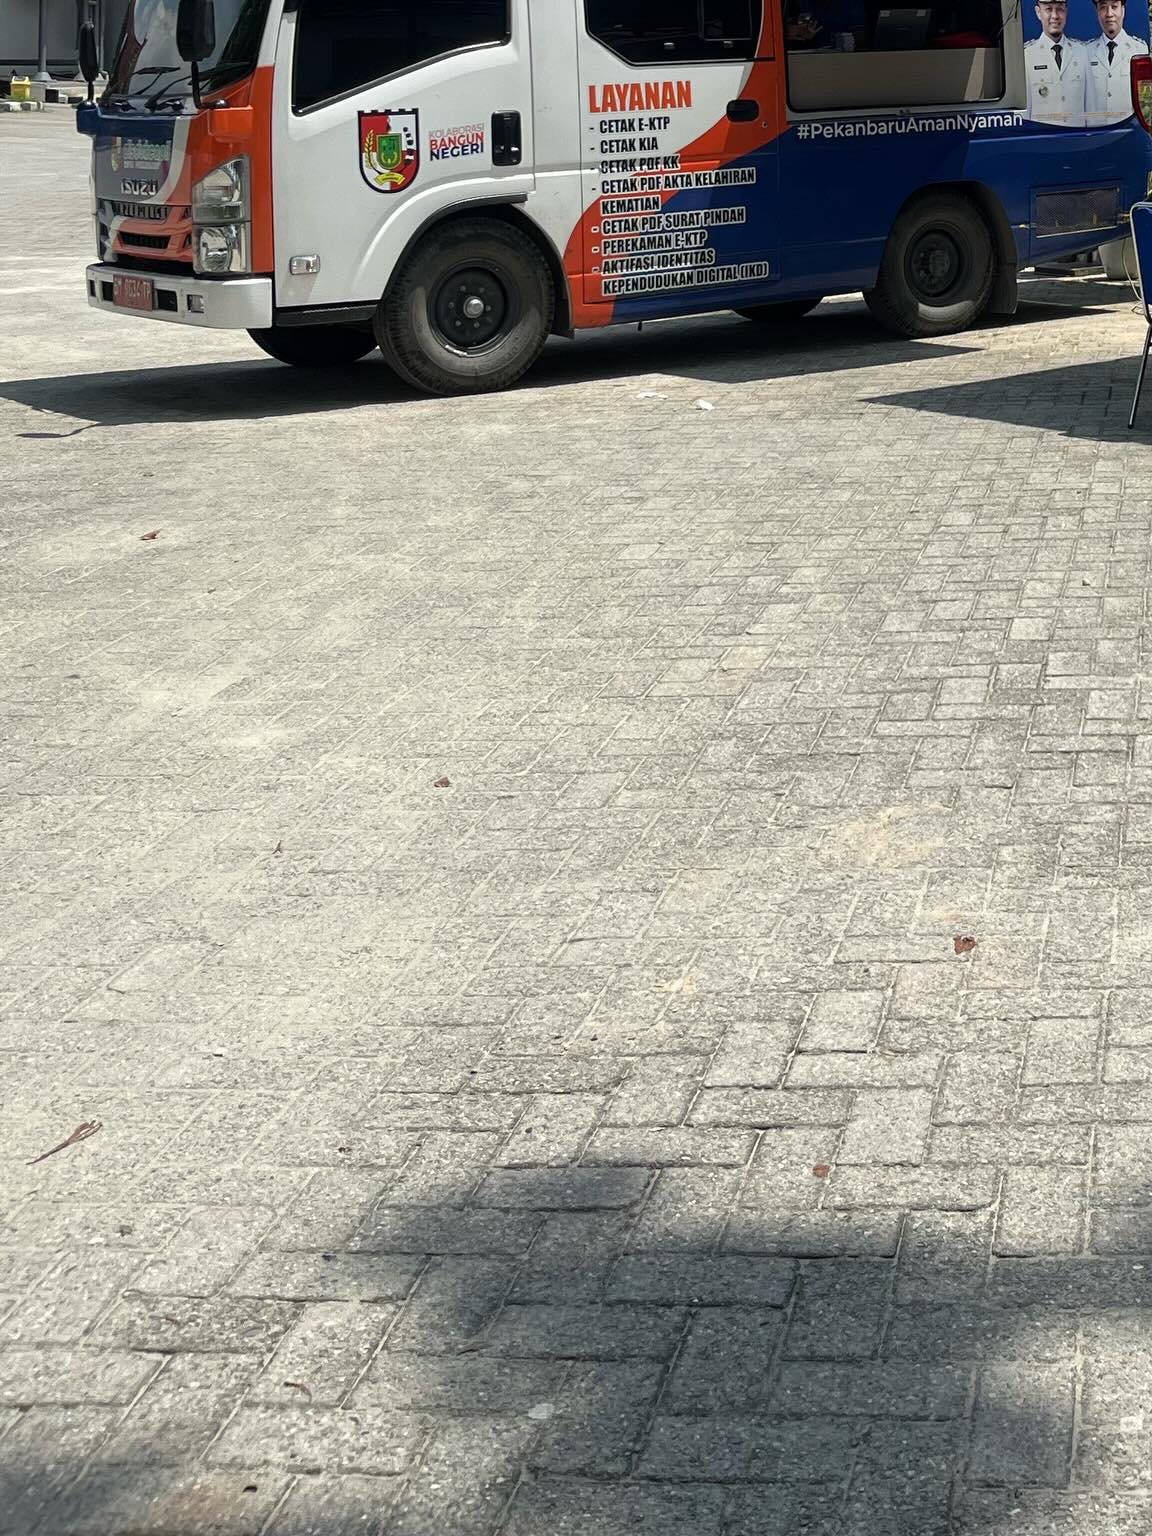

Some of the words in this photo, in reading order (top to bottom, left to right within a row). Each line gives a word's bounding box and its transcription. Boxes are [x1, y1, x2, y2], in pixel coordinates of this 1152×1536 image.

[588, 80, 692, 113] LAYANAN
[429, 123, 484, 138] KOLABORASI
[600, 118, 636, 133] CETAK
[639, 116, 670, 131] E-KTP
[797, 112, 1023, 139] #PekanbaruAmanNyaman
[430, 131, 484, 150] BANGUN
[430, 140, 484, 161] NEGERI
[600, 138, 636, 154] CETAK
[639, 137, 658, 151] KIA
[601, 158, 637, 174] CETAK
[639, 156, 662, 171] PDF
[664, 155, 680, 169] KK
[121, 180, 157, 196] ISUZU
[601, 178, 638, 194] CETAK
[641, 175, 662, 191] PDF
[664, 173, 692, 189] AKTA
[695, 169, 755, 187] KELAHIRAN
[601, 196, 660, 214] KEMATIAN
[603, 218, 639, 234] CETAK
[641, 216, 662, 232] PDF
[666, 213, 701, 229] SURAT
[704, 208, 744, 225] PINDAH
[603, 236, 672, 254] PEREKAMAN
[675, 232, 707, 247] E-KTP
[603, 257, 655, 274] AKTIFASI
[657, 250, 714, 269] IDENTITAS
[603, 273, 694, 295] KEPENDUDUKAN
[697, 266, 738, 284] DIGITAL
[740, 263, 768, 279] (IKD)
